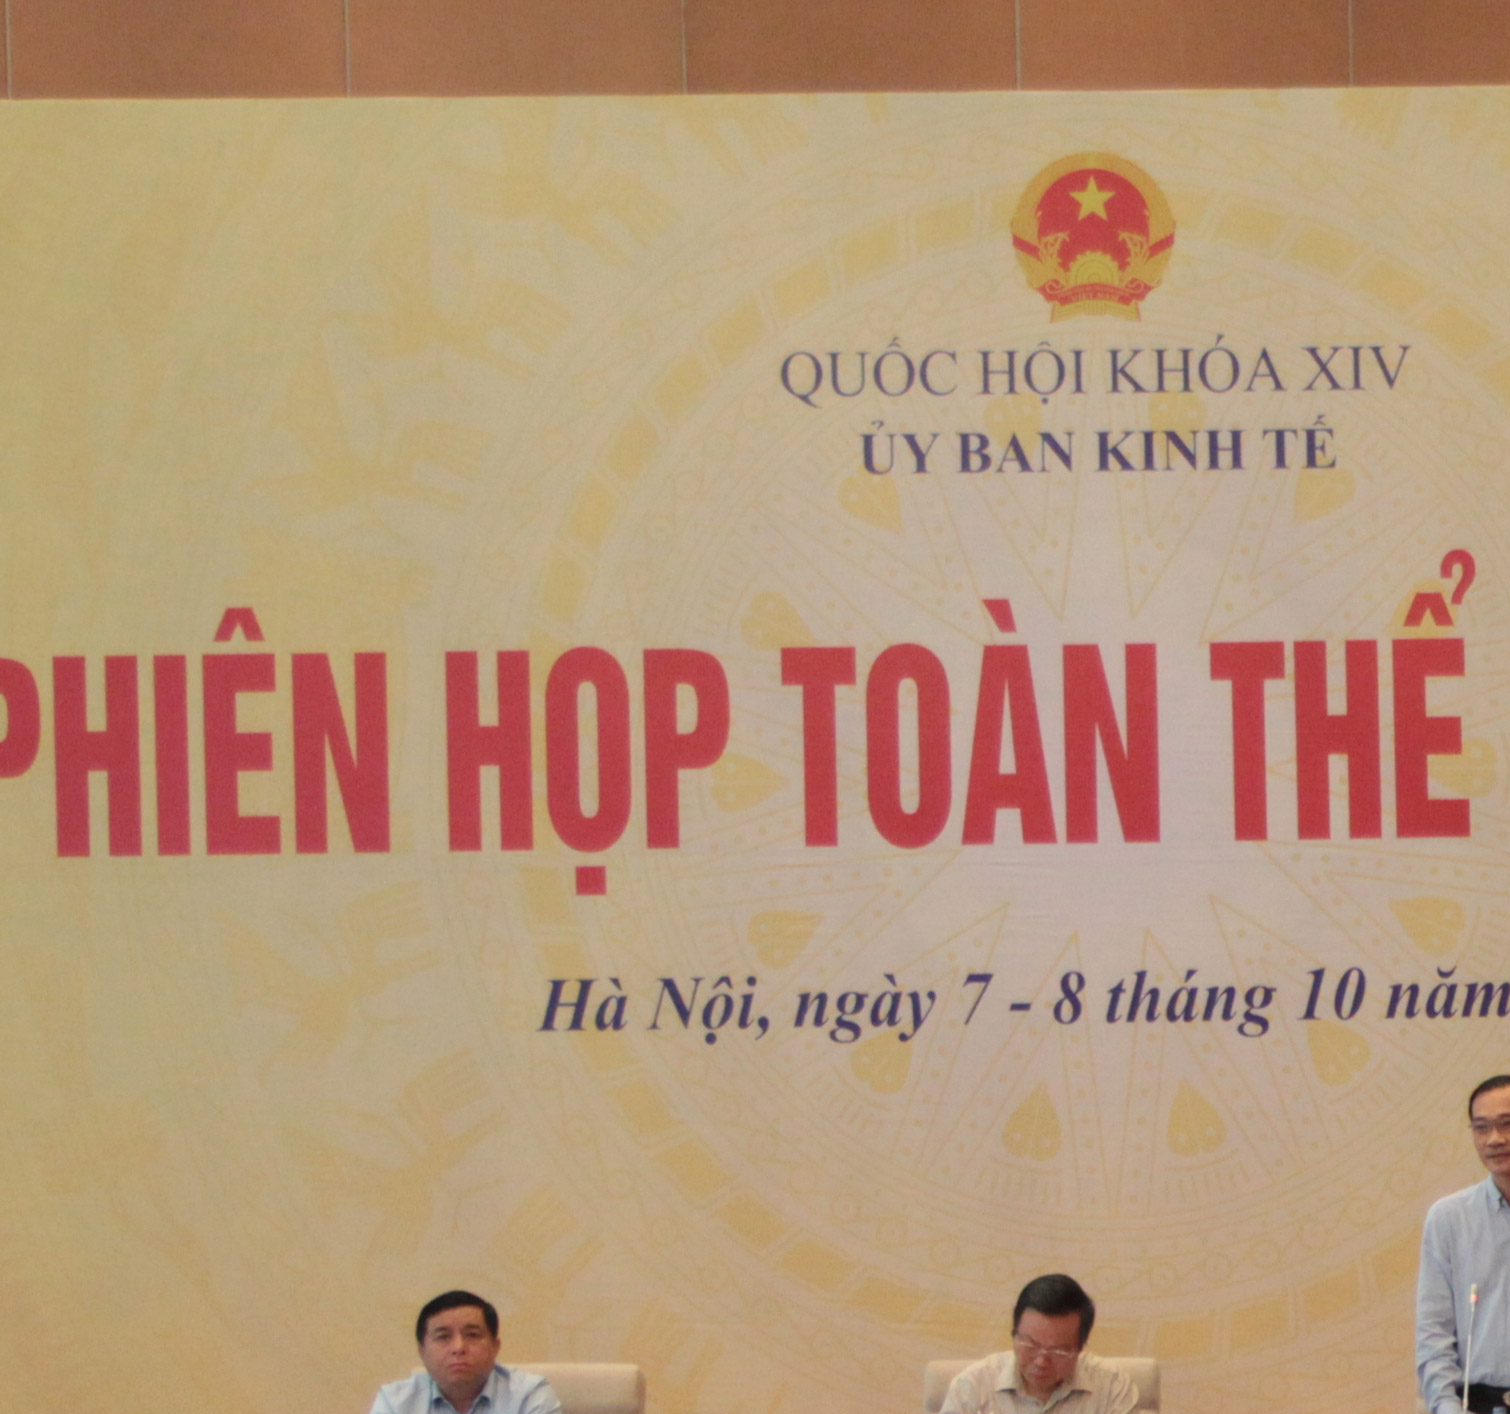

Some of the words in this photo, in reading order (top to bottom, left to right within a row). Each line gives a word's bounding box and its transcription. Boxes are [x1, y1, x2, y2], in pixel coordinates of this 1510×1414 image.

[780, 336, 958, 409] QUỐC
[977, 340, 1087, 405] HỘI
[1106, 334, 1287, 394] KHÓA
[1301, 345, 1412, 392] XIV
[860, 420, 941, 476] ỦY
[956, 431, 1076, 474] BAN
[1094, 429, 1247, 472] KINH
[1261, 414, 1338, 470] TẾ
[445, 645, 731, 896] HỌP
[780, 598, 1161, 849] TOÀN
[1209, 549, 1476, 841] THỂ
[536, 976, 628, 1032] Hà
[648, 975, 771, 1046] Nội,
[793, 973, 938, 1044] ngày
[962, 972, 995, 1026] 7
[1052, 970, 1087, 1026] 8
[1105, 968, 1278, 1038] tháng
[1298, 966, 1367, 1021] 10
